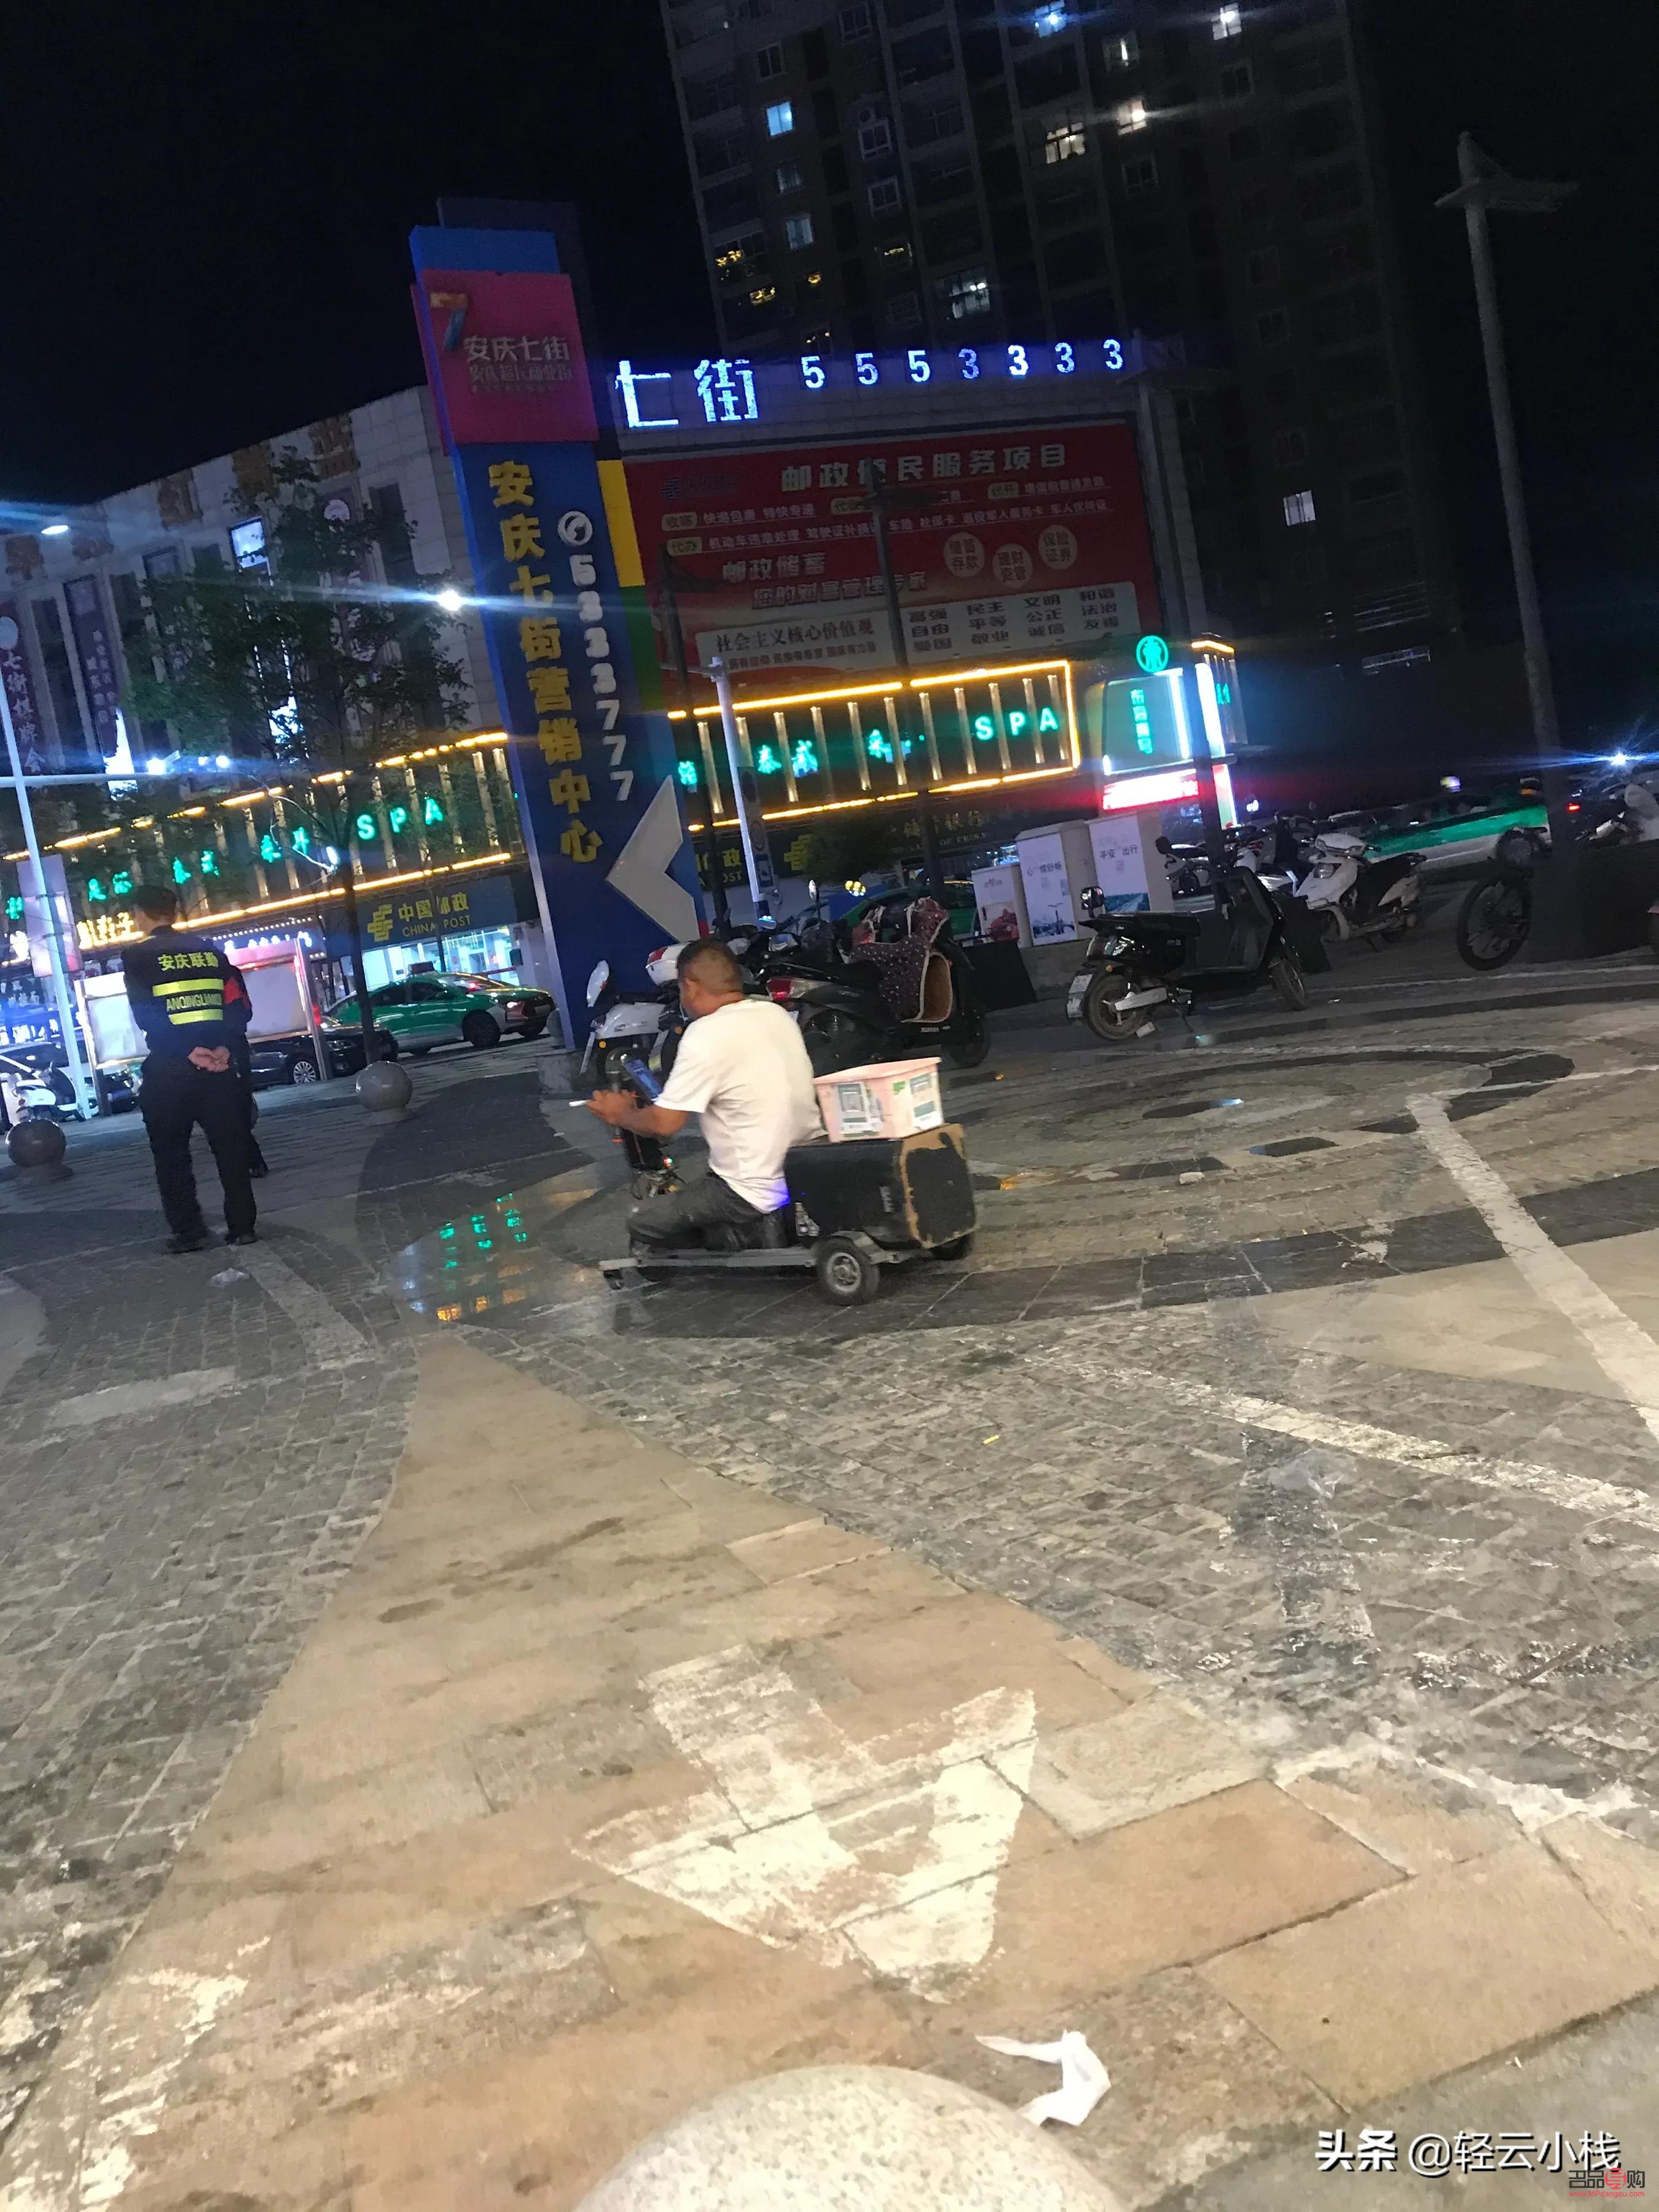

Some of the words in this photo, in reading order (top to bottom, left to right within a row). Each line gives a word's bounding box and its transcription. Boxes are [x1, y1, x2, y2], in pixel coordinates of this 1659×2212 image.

[463, 335, 570, 363] 安庆七街
[616, 359, 759, 428] 七街
[801, 339, 1124, 389] 5553333
[1043, 531, 1069, 546] 保险
[722, 552, 826, 584] 邮政储蓄
[967, 601, 1004, 615] 民主
[1024, 594, 1061, 608] 文明
[1079, 587, 1115, 600] 和谐
[717, 618, 874, 653] 社会主义核心价值观
[911, 623, 949, 637] 自由
[969, 615, 1006, 630] 平等
[1026, 608, 1062, 622] 公正
[1081, 602, 1117, 616] 法治
[971, 630, 1009, 645] 敬业
[1028, 623, 1064, 637] 诚信
[489, 461, 603, 862] 安庆七街营销中心
[975, 707, 1059, 741] SPA
[357, 798, 444, 840] SPA
[402, 923, 436, 938] CHINA
[444, 915, 472, 930] POST
